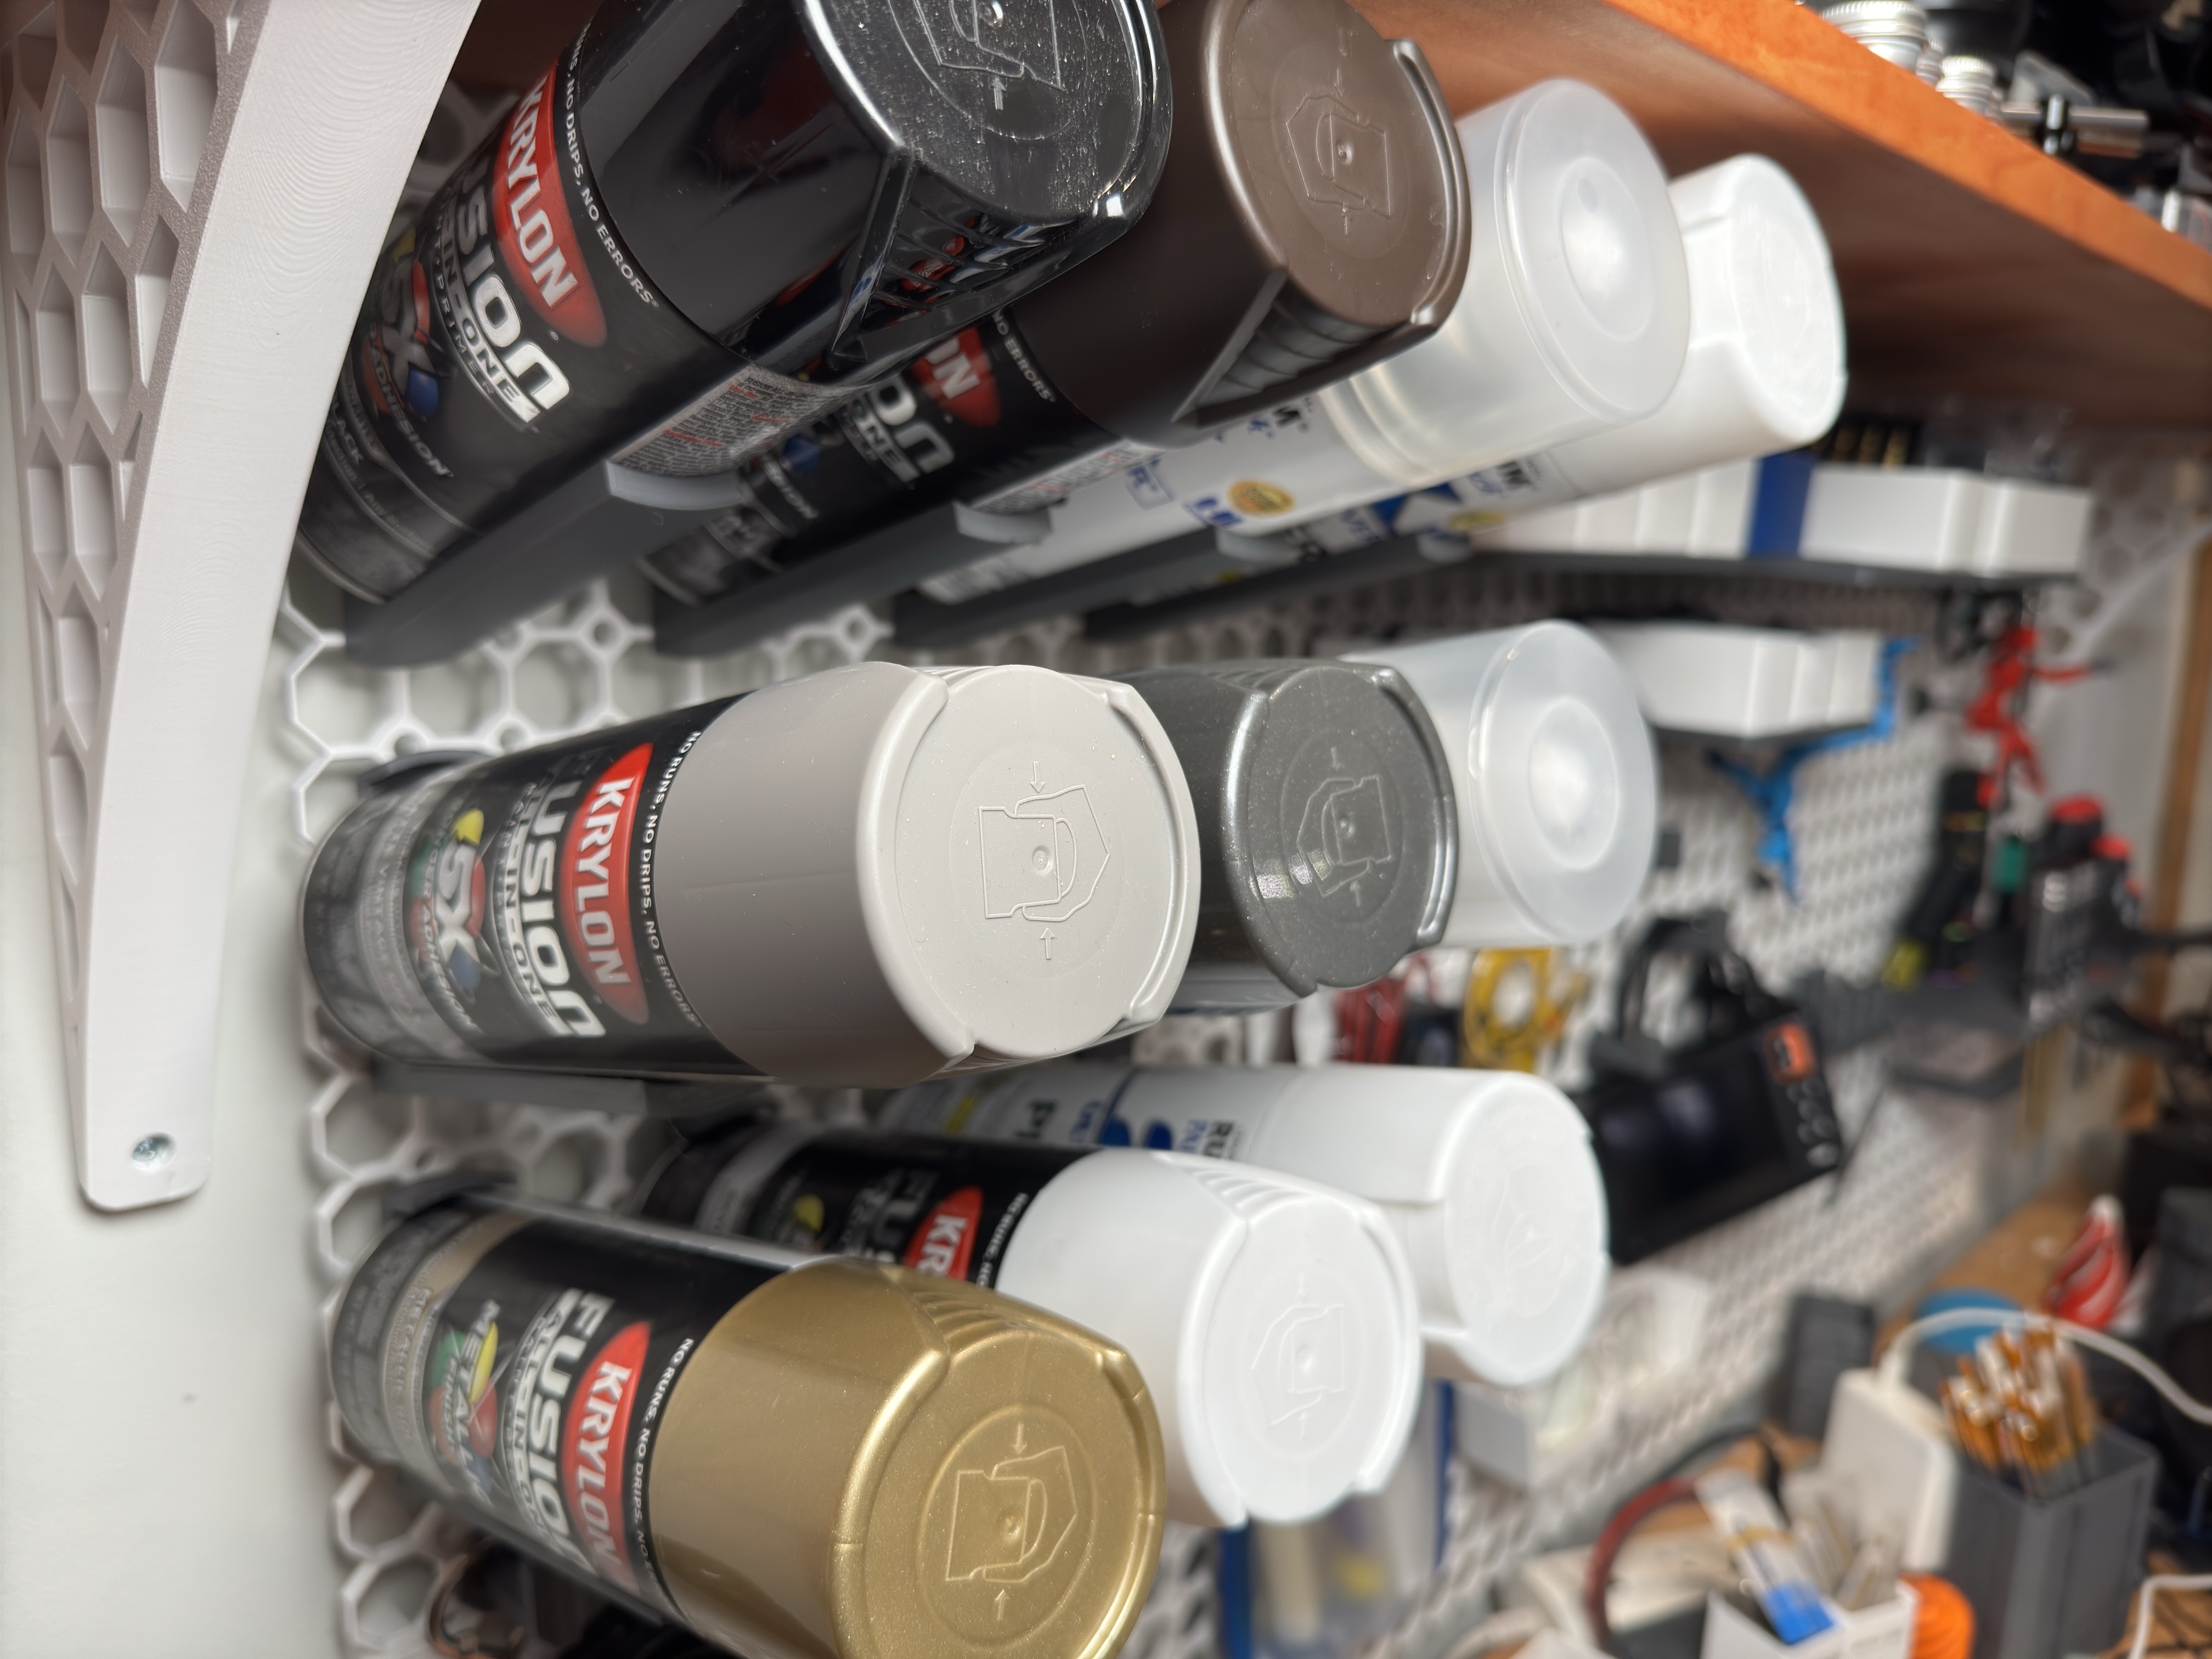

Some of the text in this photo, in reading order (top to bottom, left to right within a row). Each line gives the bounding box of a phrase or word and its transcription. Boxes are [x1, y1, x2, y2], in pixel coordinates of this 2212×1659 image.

[565, 81, 575, 108] NO
[566, 112, 585, 186] DRIPS,
[508, 74, 579, 308] KRYLON
[582, 187, 600, 221] NO
[458, 165, 571, 410] SION
[679, 730, 702, 755] NO
[651, 757, 682, 812] RUNS,
[642, 814, 661, 846] NO
[437, 839, 481, 964] 5X
[505, 782, 562, 1020] LL-IN-ONE
[575, 775, 636, 986] KRYLON
[639, 848, 652, 916] DRIPS,
[644, 920, 661, 950] NO
[672, 1338, 695, 1364] NO
[454, 1298, 501, 1509] METALLIC
[643, 1365, 675, 1424] RUNS,
[576, 1361, 634, 1566] KRYLON
[636, 1427, 651, 1462] NO
[630, 1462, 645, 1527] DRIPS,
[635, 1528, 651, 1558] NO
